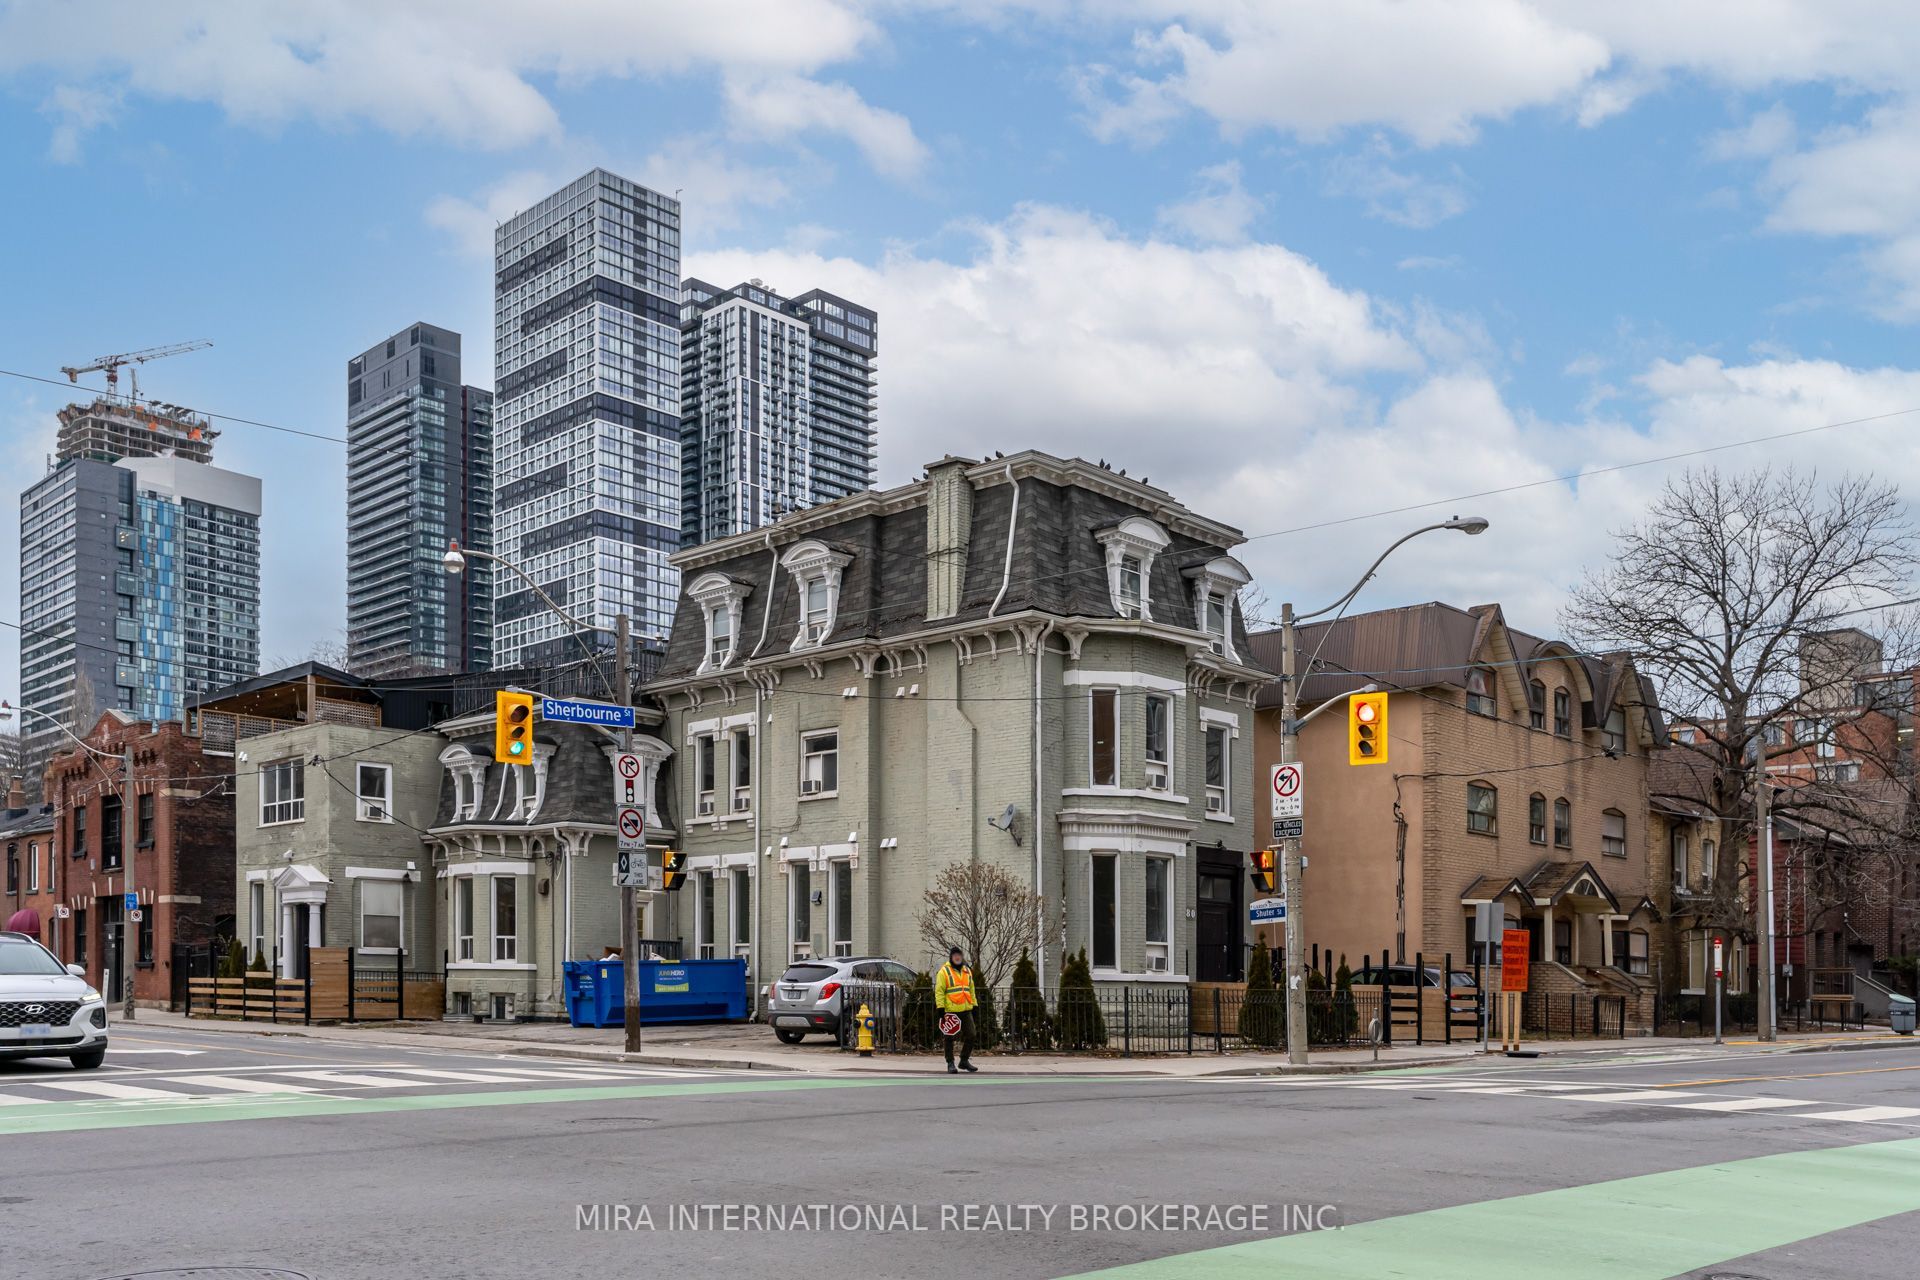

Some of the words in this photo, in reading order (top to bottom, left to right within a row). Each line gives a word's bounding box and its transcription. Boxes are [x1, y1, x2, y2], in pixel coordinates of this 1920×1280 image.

[546, 701, 622, 721] Sherbourne
[1256, 910, 1274, 918] Shuter
[942, 1015, 960, 1033] STOP
